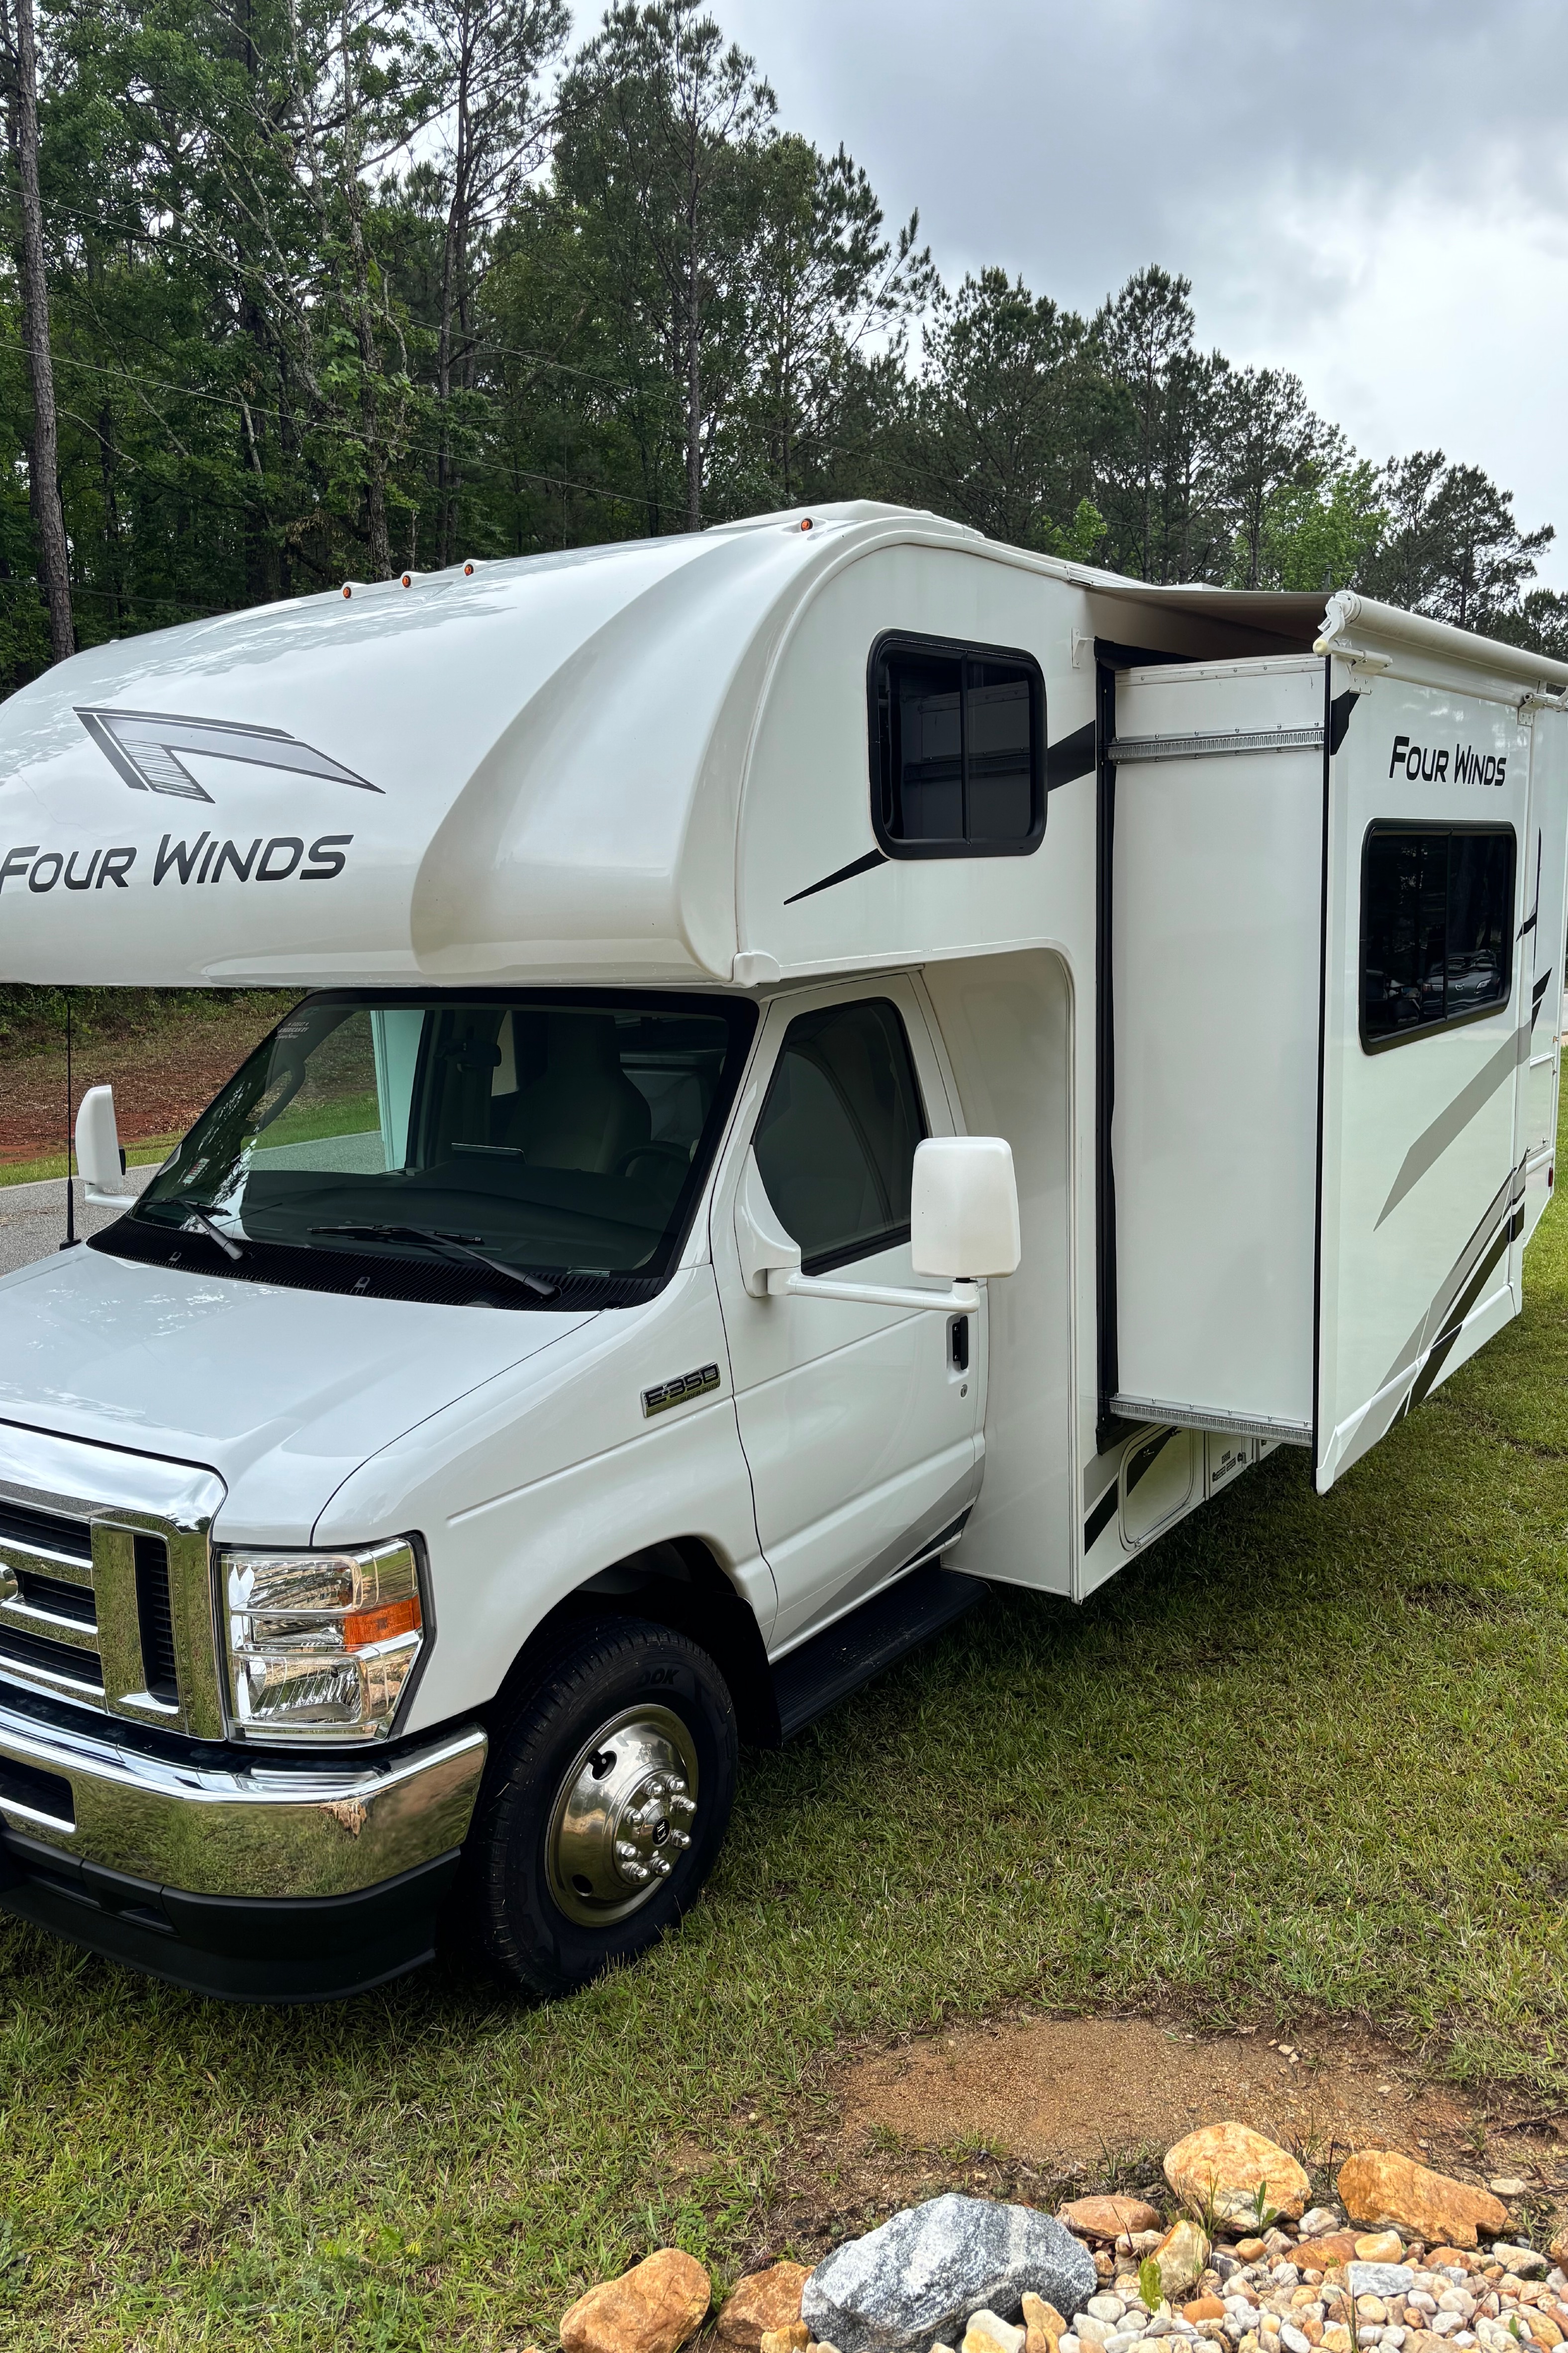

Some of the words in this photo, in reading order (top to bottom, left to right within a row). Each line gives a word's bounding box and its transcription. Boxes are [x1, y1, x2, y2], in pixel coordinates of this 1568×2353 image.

[1389, 735, 1449, 783] FOUR
[1454, 743, 1507, 786] WINDS
[0, 845, 137, 894] FOUR
[153, 831, 354, 886] WINDS
[645, 1364, 719, 1408] E-350
[680, 1390, 700, 1402] SUPER
[702, 1381, 720, 1393] DUTY
